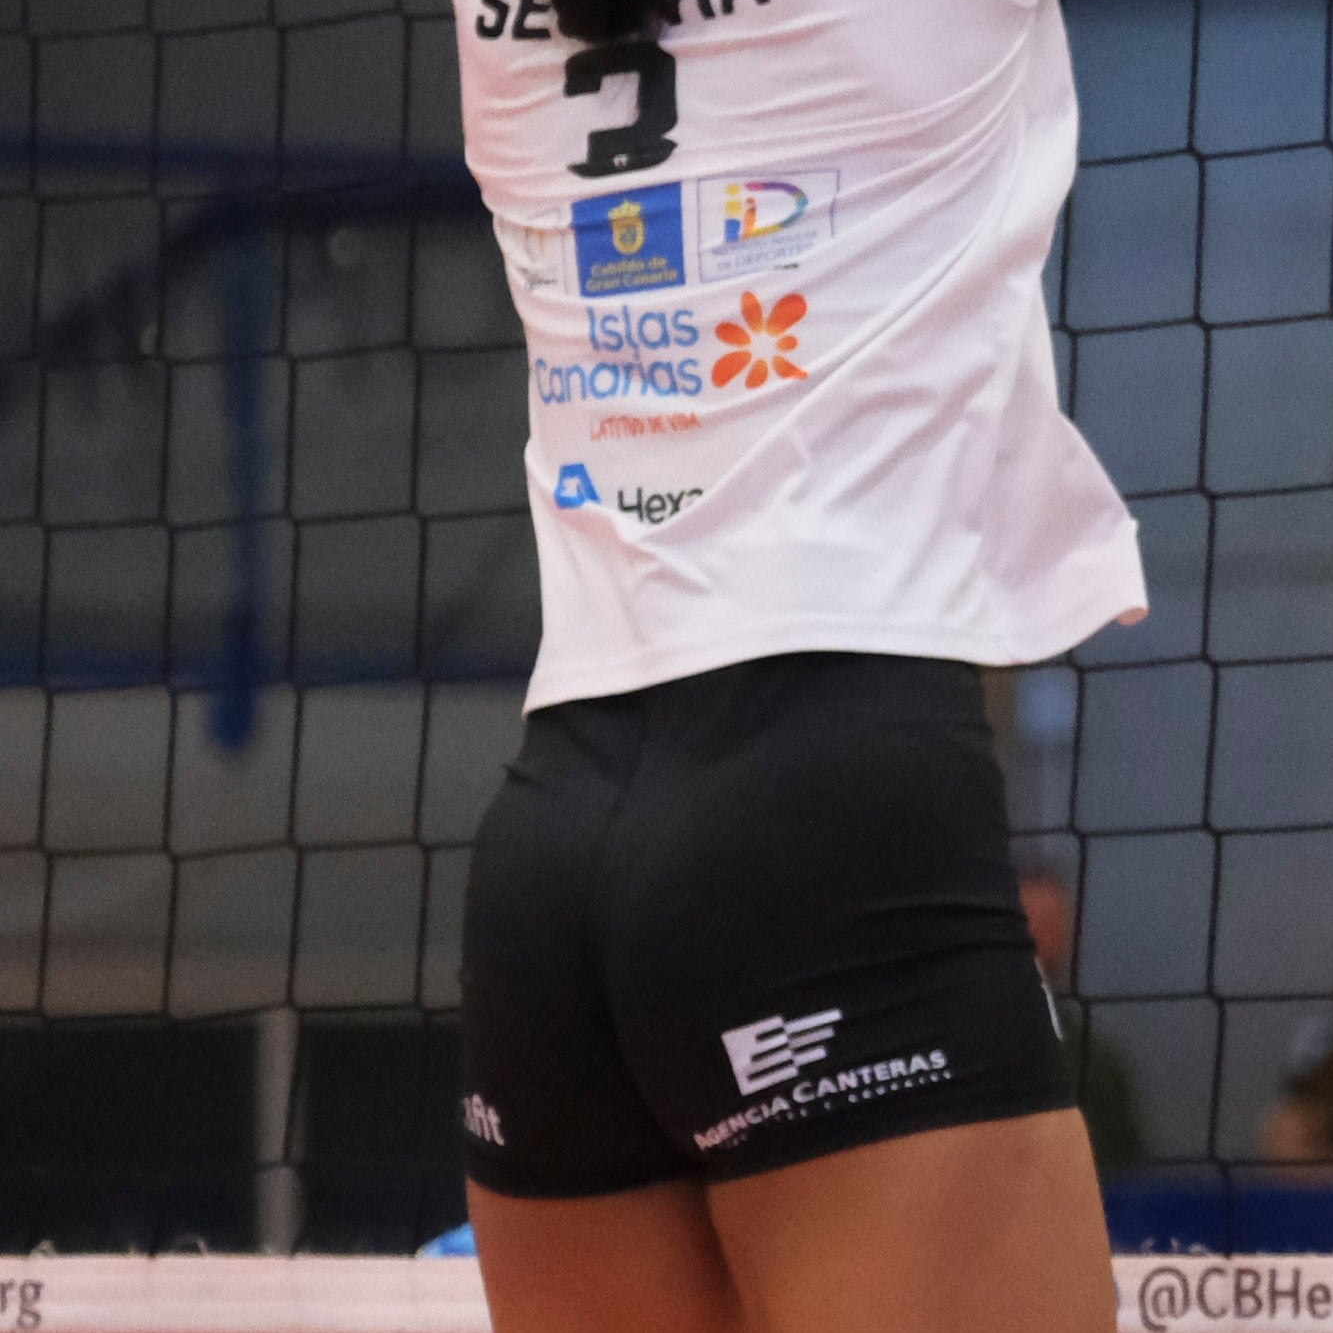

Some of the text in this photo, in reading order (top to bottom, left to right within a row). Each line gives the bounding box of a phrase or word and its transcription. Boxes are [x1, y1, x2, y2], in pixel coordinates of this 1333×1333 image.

[587, 305, 699, 352] Islas
[535, 353, 702, 405] Canarias
[792, 1050, 947, 1105] CANTERAS
